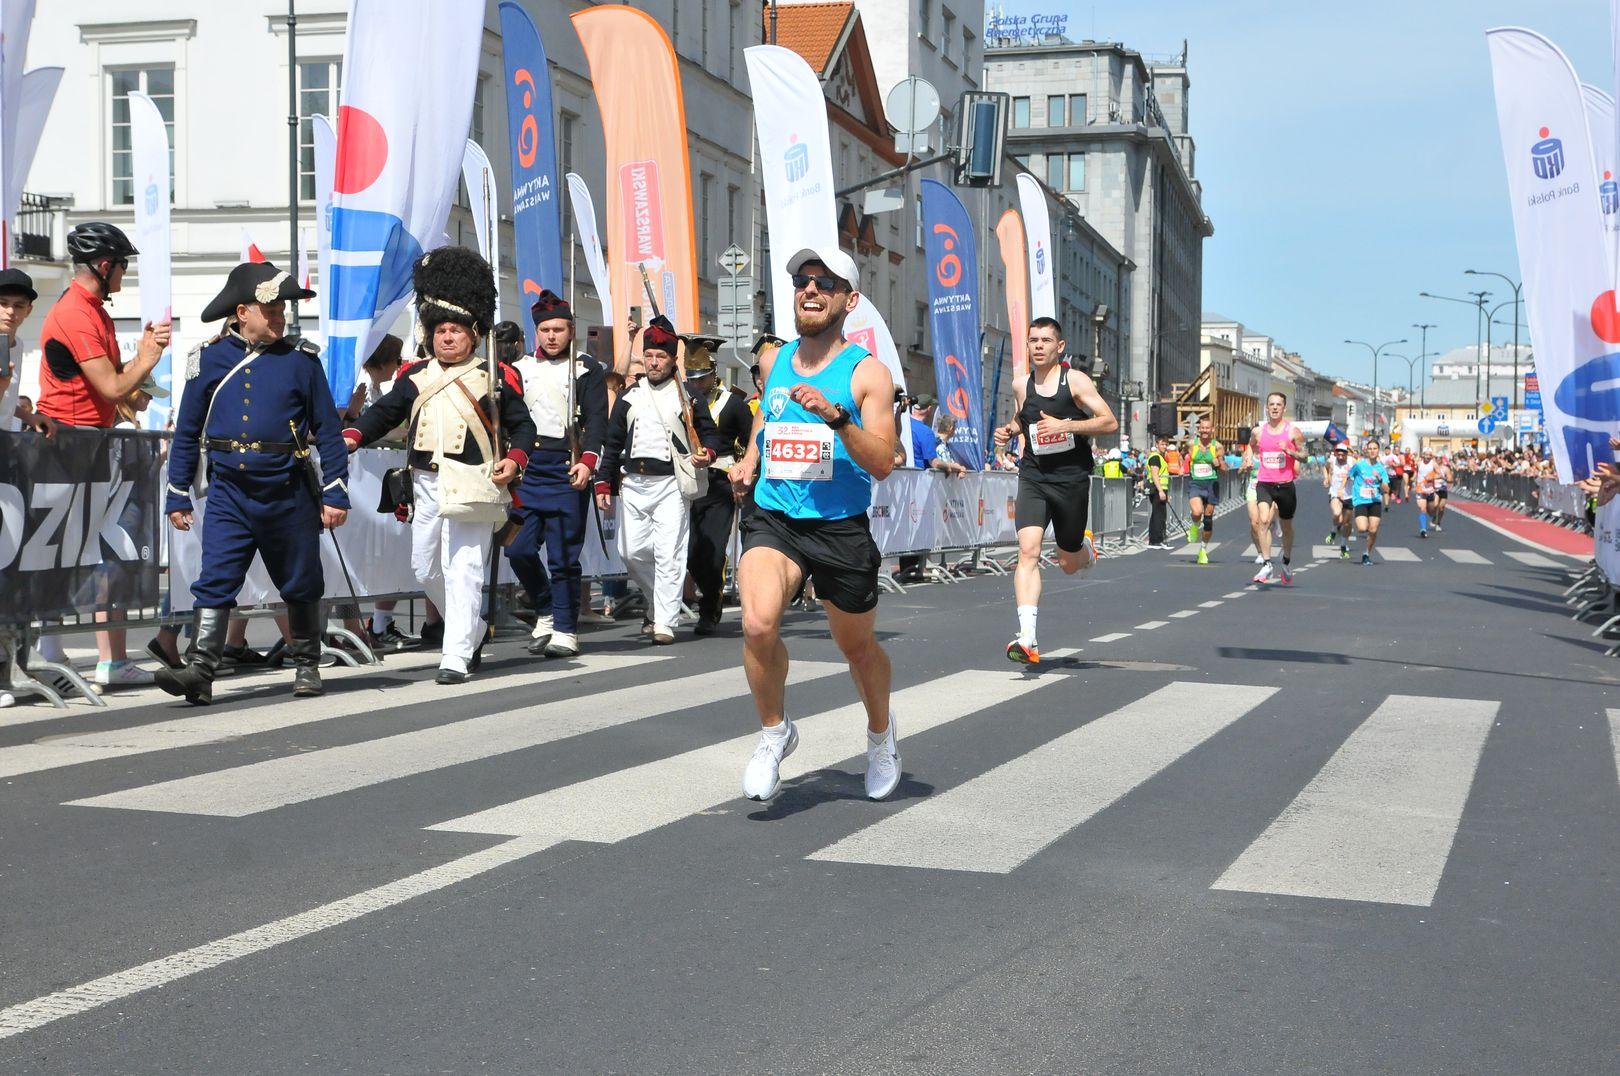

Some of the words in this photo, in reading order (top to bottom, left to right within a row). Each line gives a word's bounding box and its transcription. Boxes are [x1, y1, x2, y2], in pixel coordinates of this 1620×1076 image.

[989, 15, 1027, 26] Polska
[1031, 14, 1068, 25] Grupa
[771, 442, 819, 461] 4632
